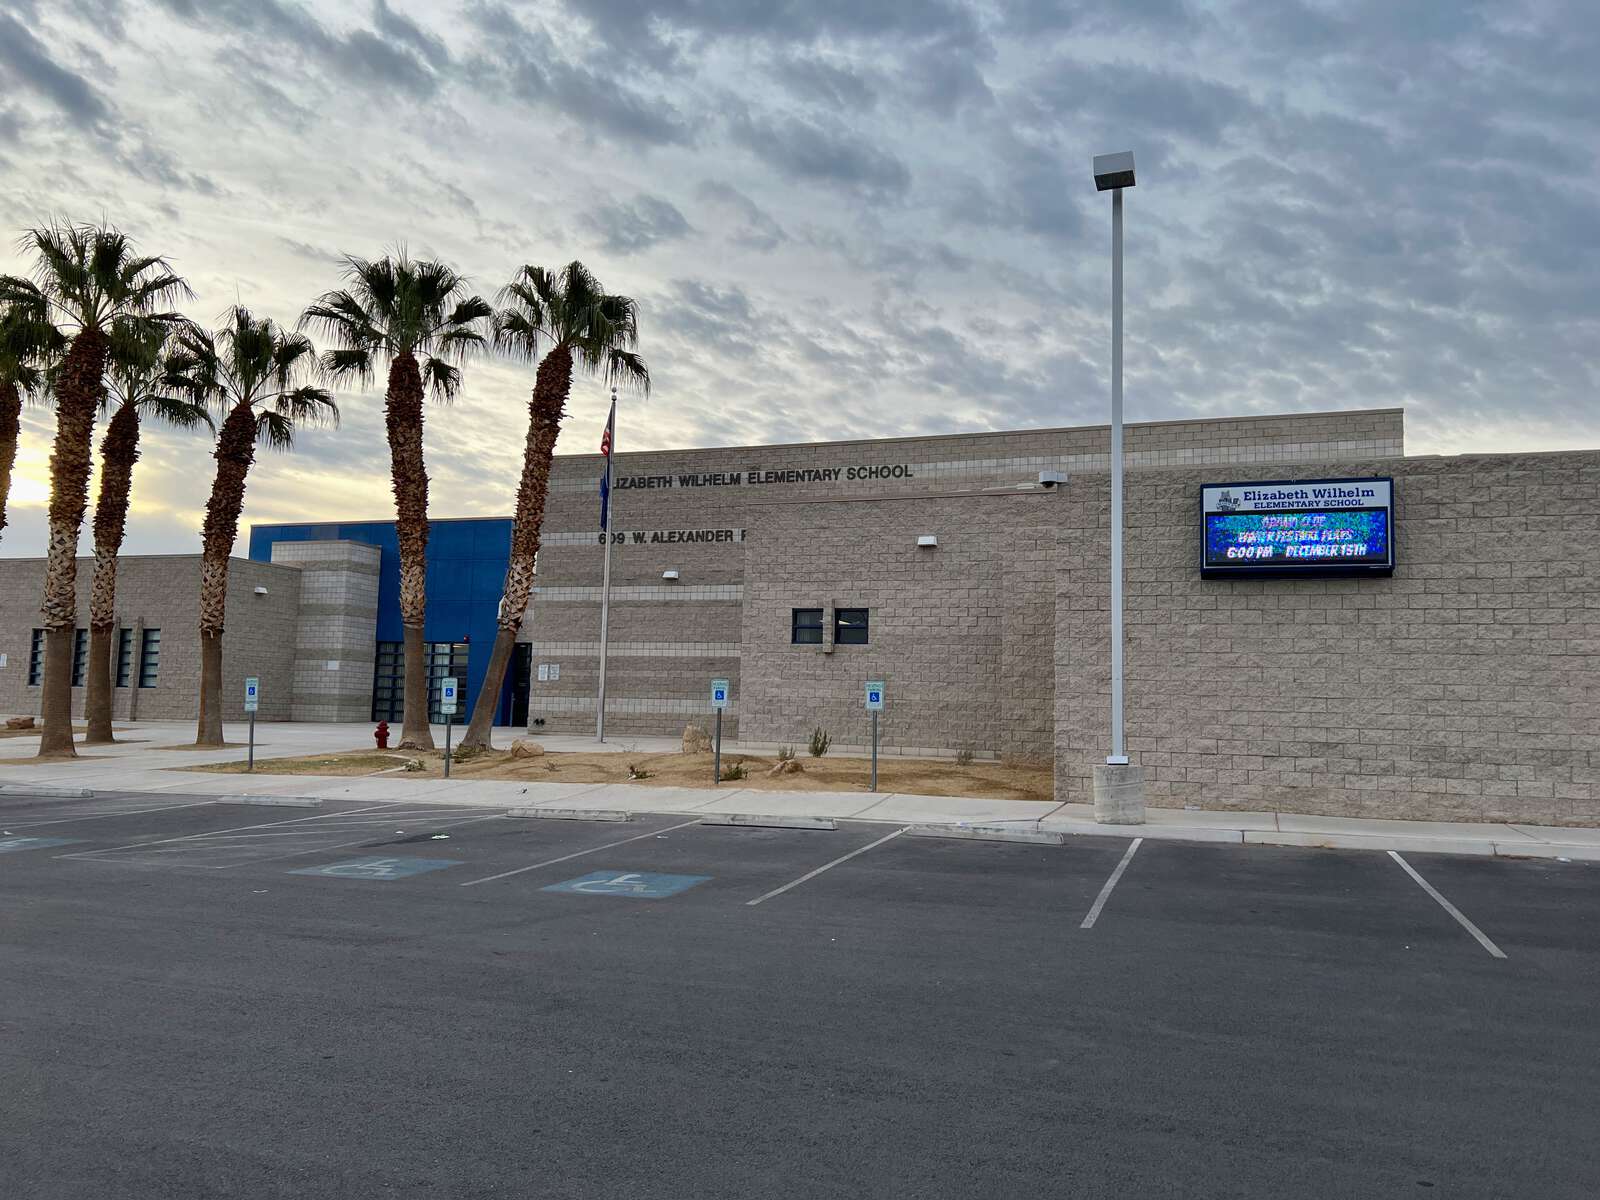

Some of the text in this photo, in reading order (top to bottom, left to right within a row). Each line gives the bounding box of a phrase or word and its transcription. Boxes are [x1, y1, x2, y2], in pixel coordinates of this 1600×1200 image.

[612, 465, 913, 489] IZABETH WILHELM ELEMENTARY SCHOOL
[1243, 487, 1374, 501] Elizabeth Wilhelm
[1254, 499, 1364, 509] ELEMENTARY SCHOOL
[632, 531, 647, 544] W.
[651, 530, 734, 543] ALEXANDER
[1256, 546, 1273, 558] PM
[1285, 544, 1338, 558] DECEMBER
